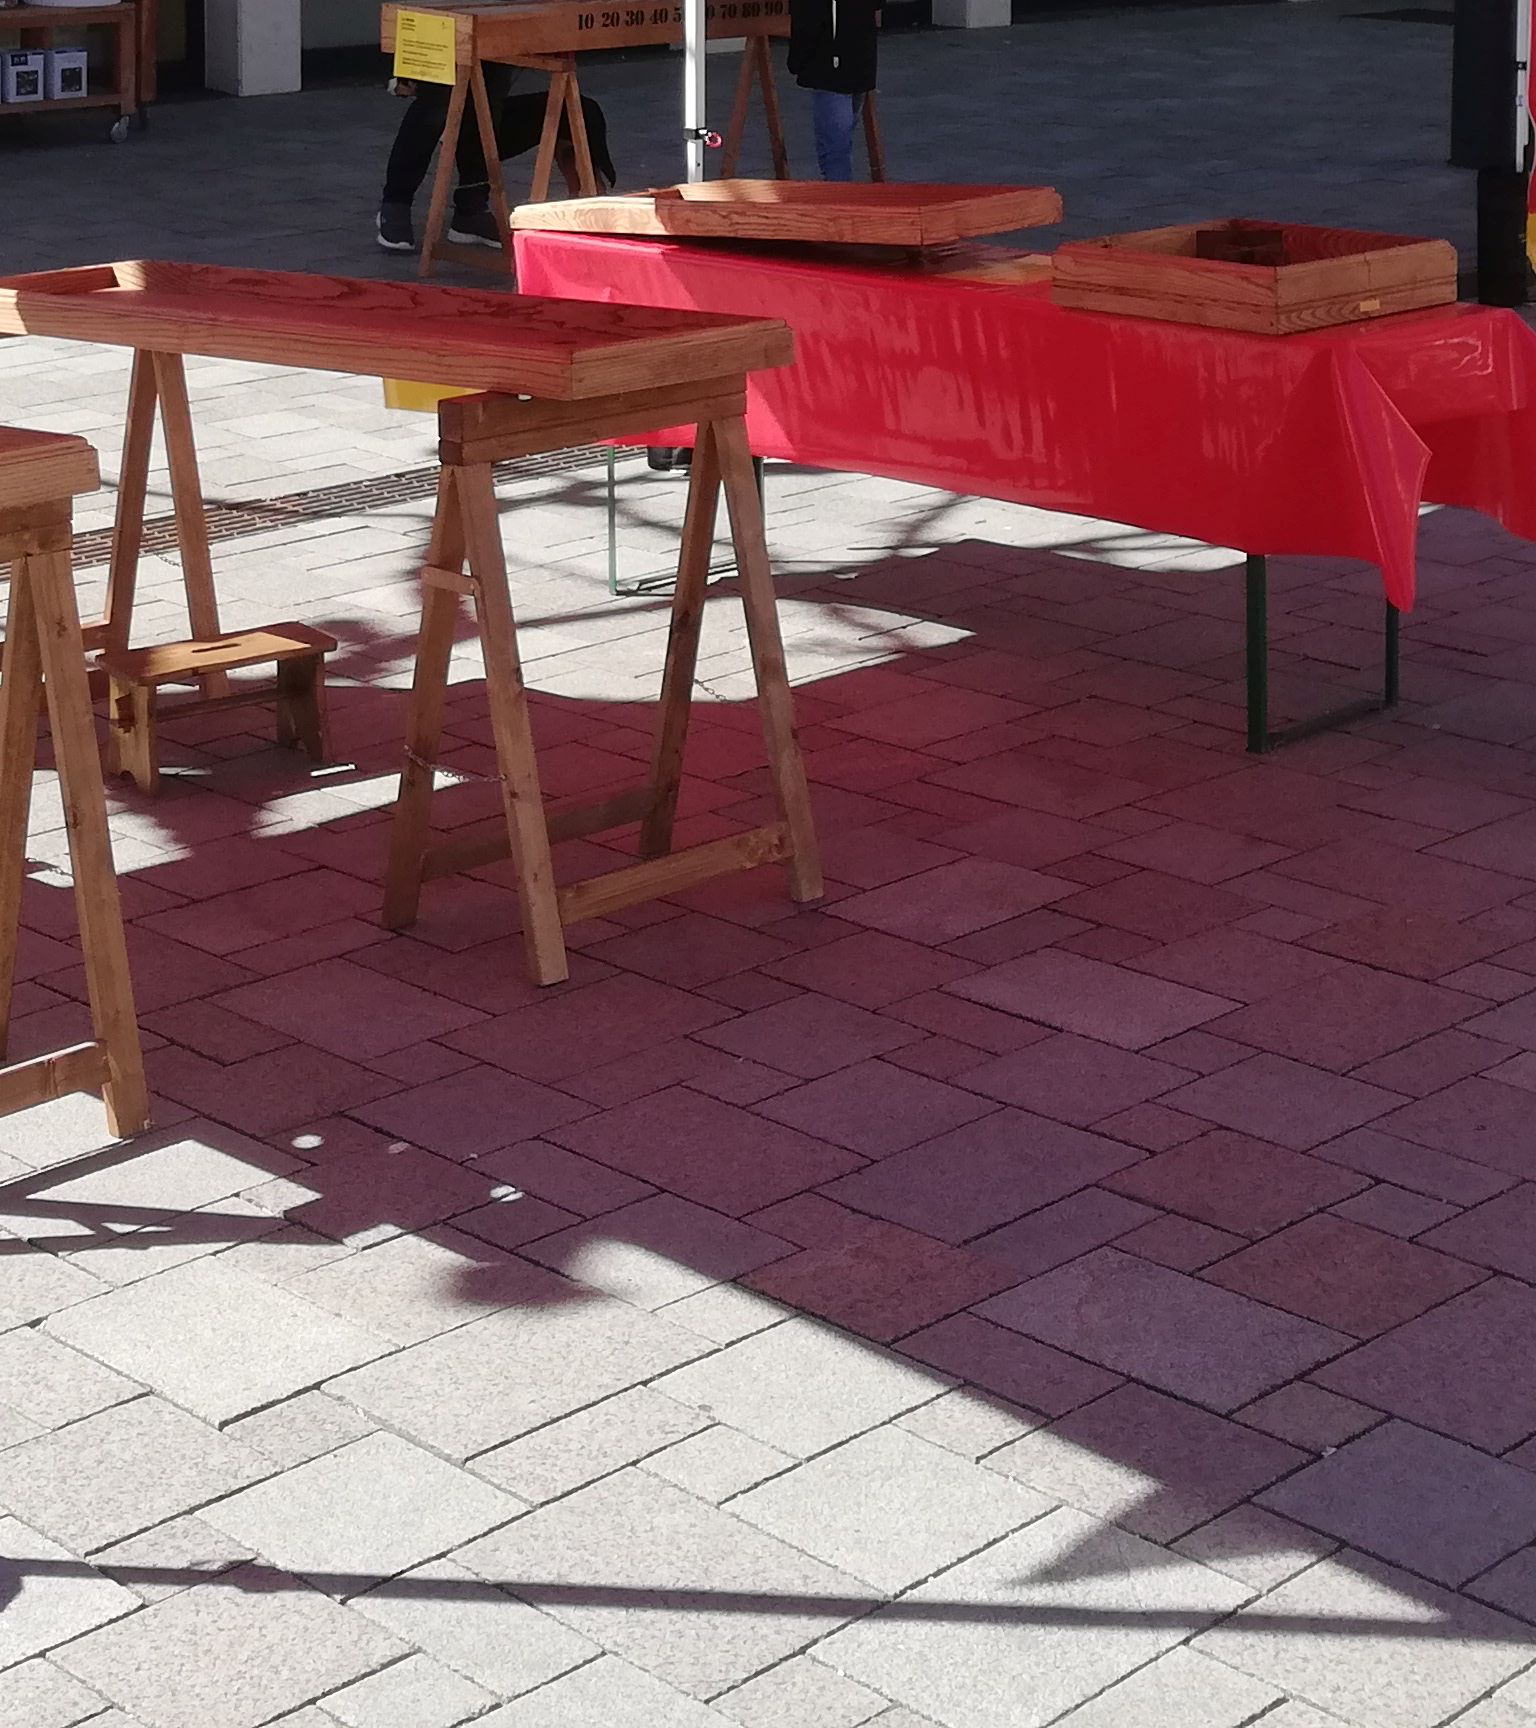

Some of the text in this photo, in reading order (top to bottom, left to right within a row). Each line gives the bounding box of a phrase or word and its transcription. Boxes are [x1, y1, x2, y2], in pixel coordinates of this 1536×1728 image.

[578, 13, 595, 30] 10
[601, 12, 620, 28] 20
[625, 10, 645, 26] 30
[649, 8, 668, 25] 40
[673, 7, 683, 24] 5
[720, 4, 737, 20] 70
[741, 2, 760, 19] 80
[765, 0, 784, 16] 90
